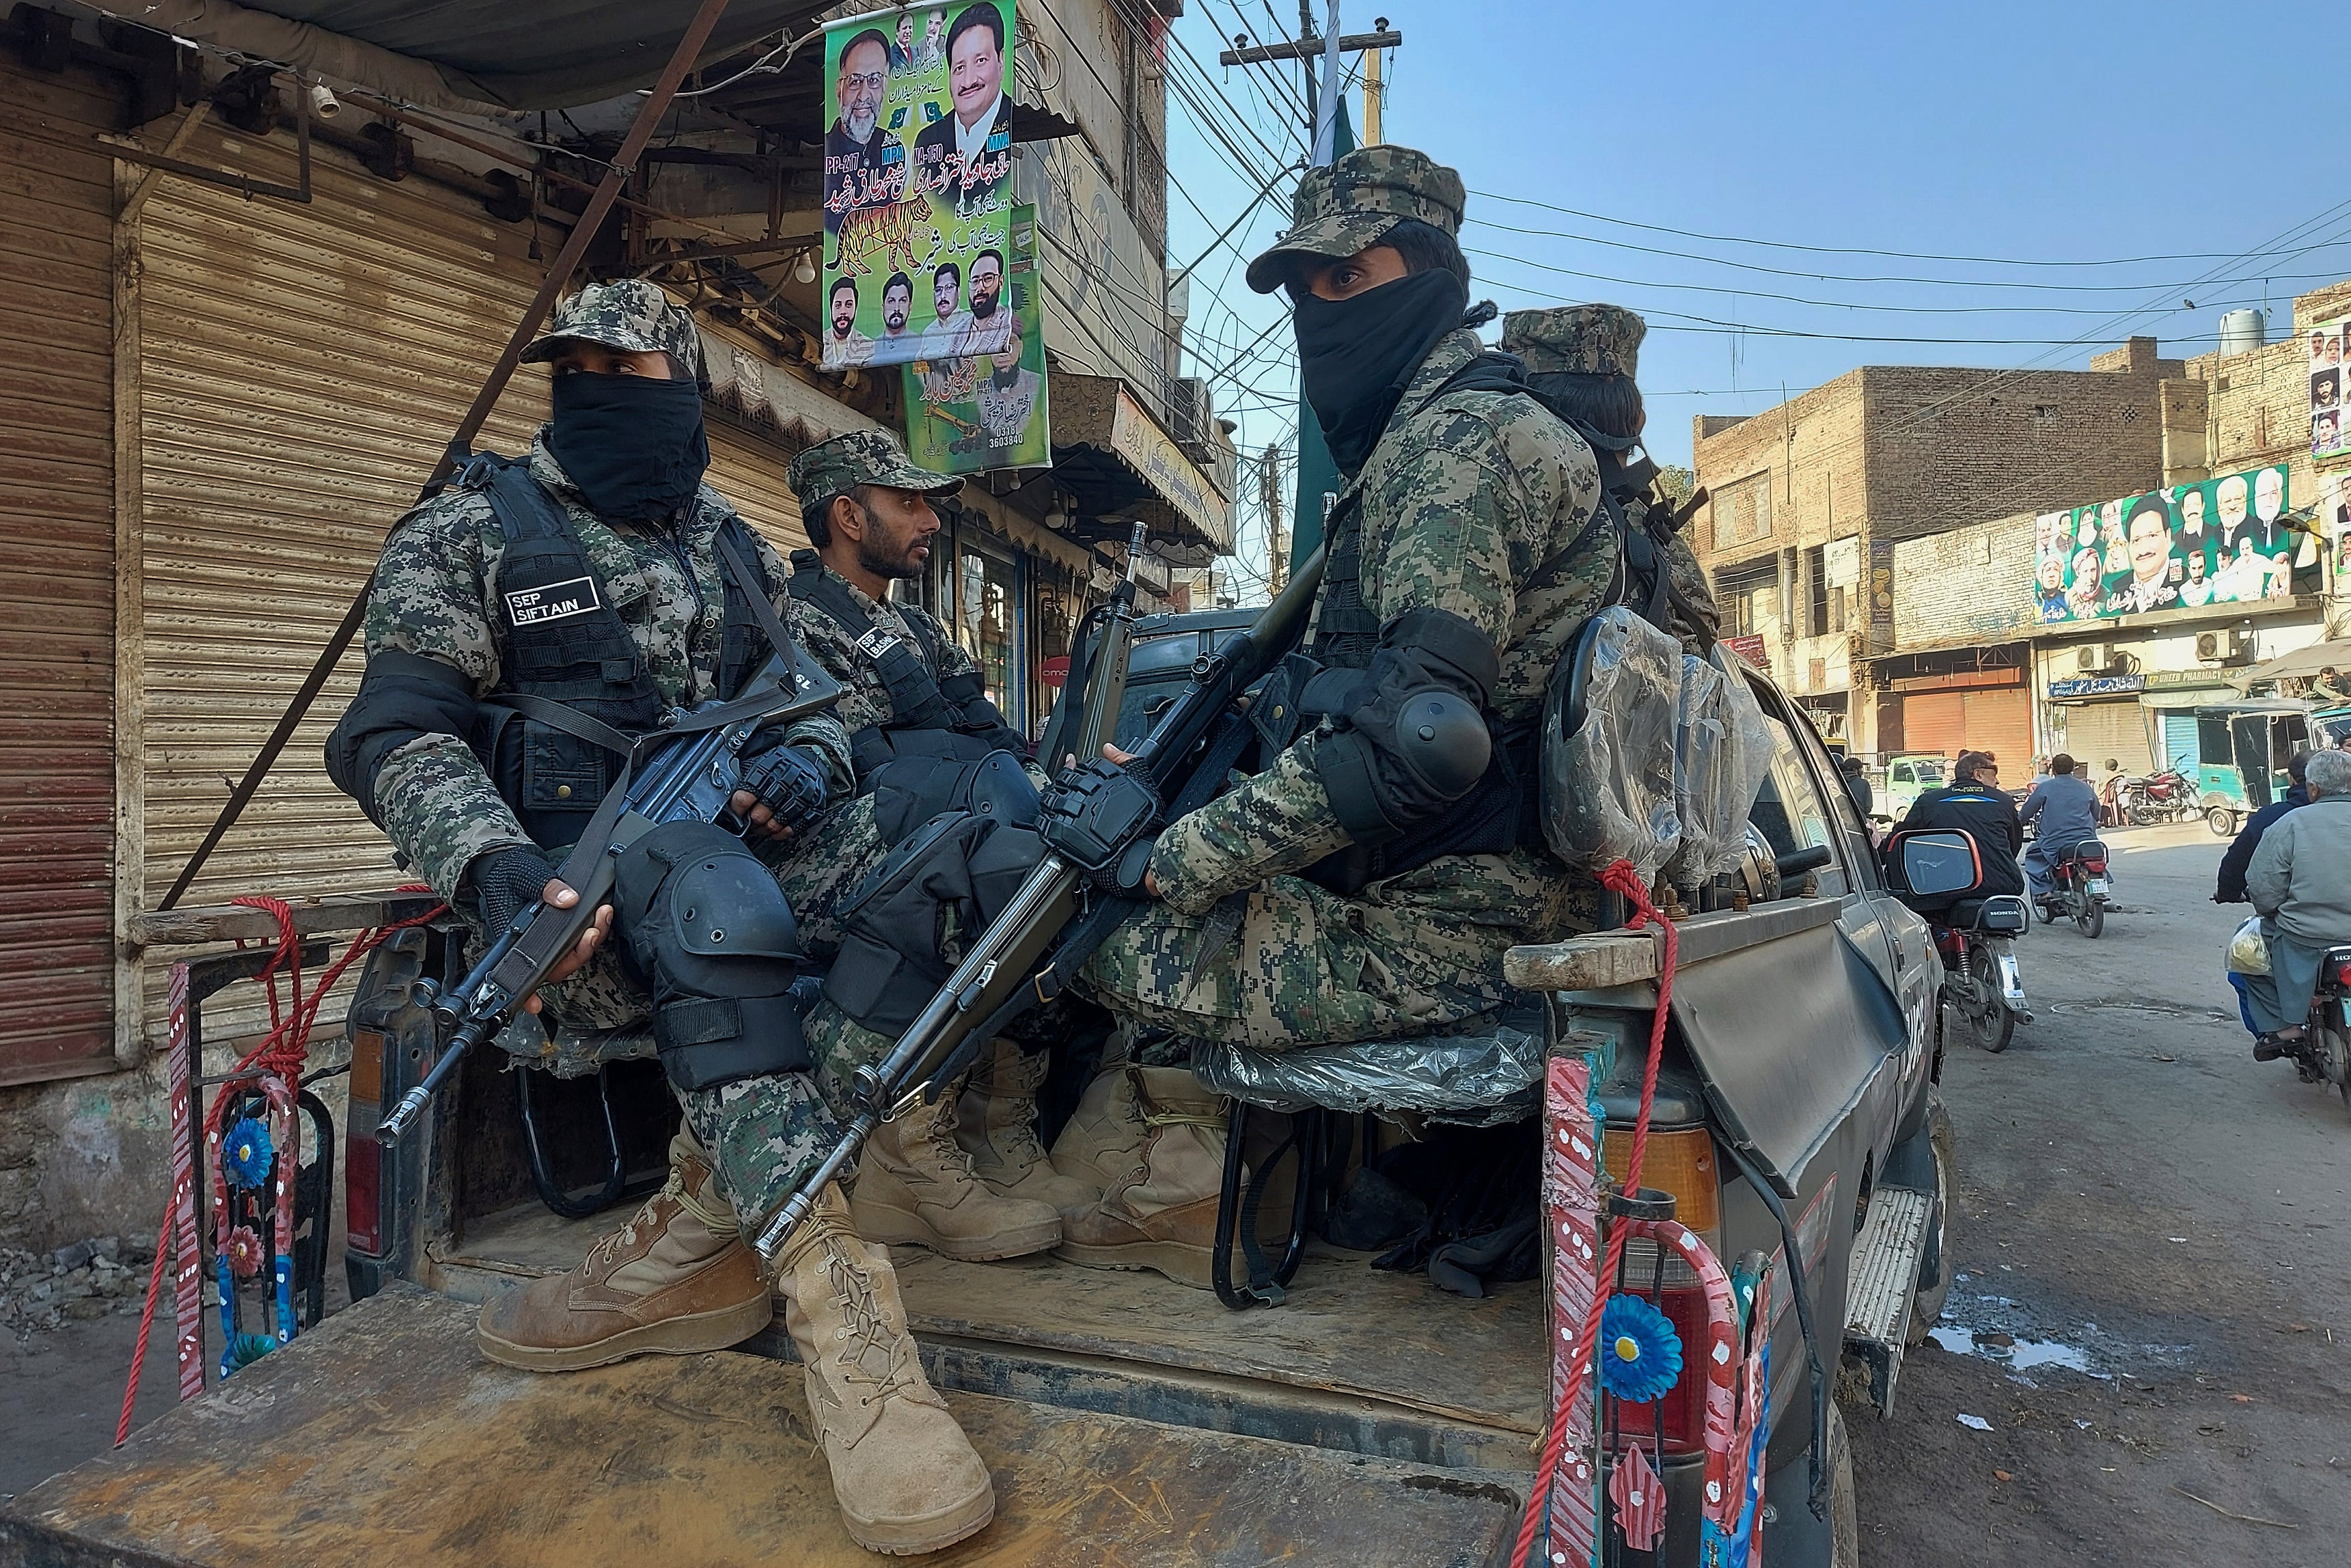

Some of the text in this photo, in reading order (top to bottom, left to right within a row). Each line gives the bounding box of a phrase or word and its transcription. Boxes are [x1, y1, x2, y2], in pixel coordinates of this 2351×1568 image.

[891, 52, 945, 80] پاکستان مسلم لیگ (ن)
[917, 81, 931, 100] نامزد
[931, 73, 945, 93] کے
[987, 130, 1010, 153] MNA
[825, 152, 860, 175] PP-217
[882, 144, 904, 165] MPA
[913, 143, 944, 166] NA-150
[891, 162, 907, 200] شیخ
[912, 149, 1010, 195] حاجی جاوید اختر انصاری
[824, 174, 853, 212] رشید
[851, 168, 883, 207] طارق
[873, 167, 896, 202] محمد
[955, 189, 1008, 225] ووٹ بھی آپ کا
[947, 221, 1006, 258] جیت بھی آپ کی
[914, 228, 944, 278] شیر
[919, 358, 978, 405] محمد حسین بابر
[976, 379, 992, 389] MPA
[976, 388, 992, 396] PP-217
[980, 393, 1032, 429] اختر رضا قریشی
[989, 434, 1023, 448] 3603840
[996, 425, 1016, 438] 0318
[512, 592, 541, 607] SEP
[517, 599, 579, 621] SIFTAIN
[861, 633, 877, 648] SEP
[2086, 678, 2113, 694] میڈیکل
[2126, 675, 2140, 689] اللہ
[2159, 670, 2221, 683] UNEEB PHARMACY
